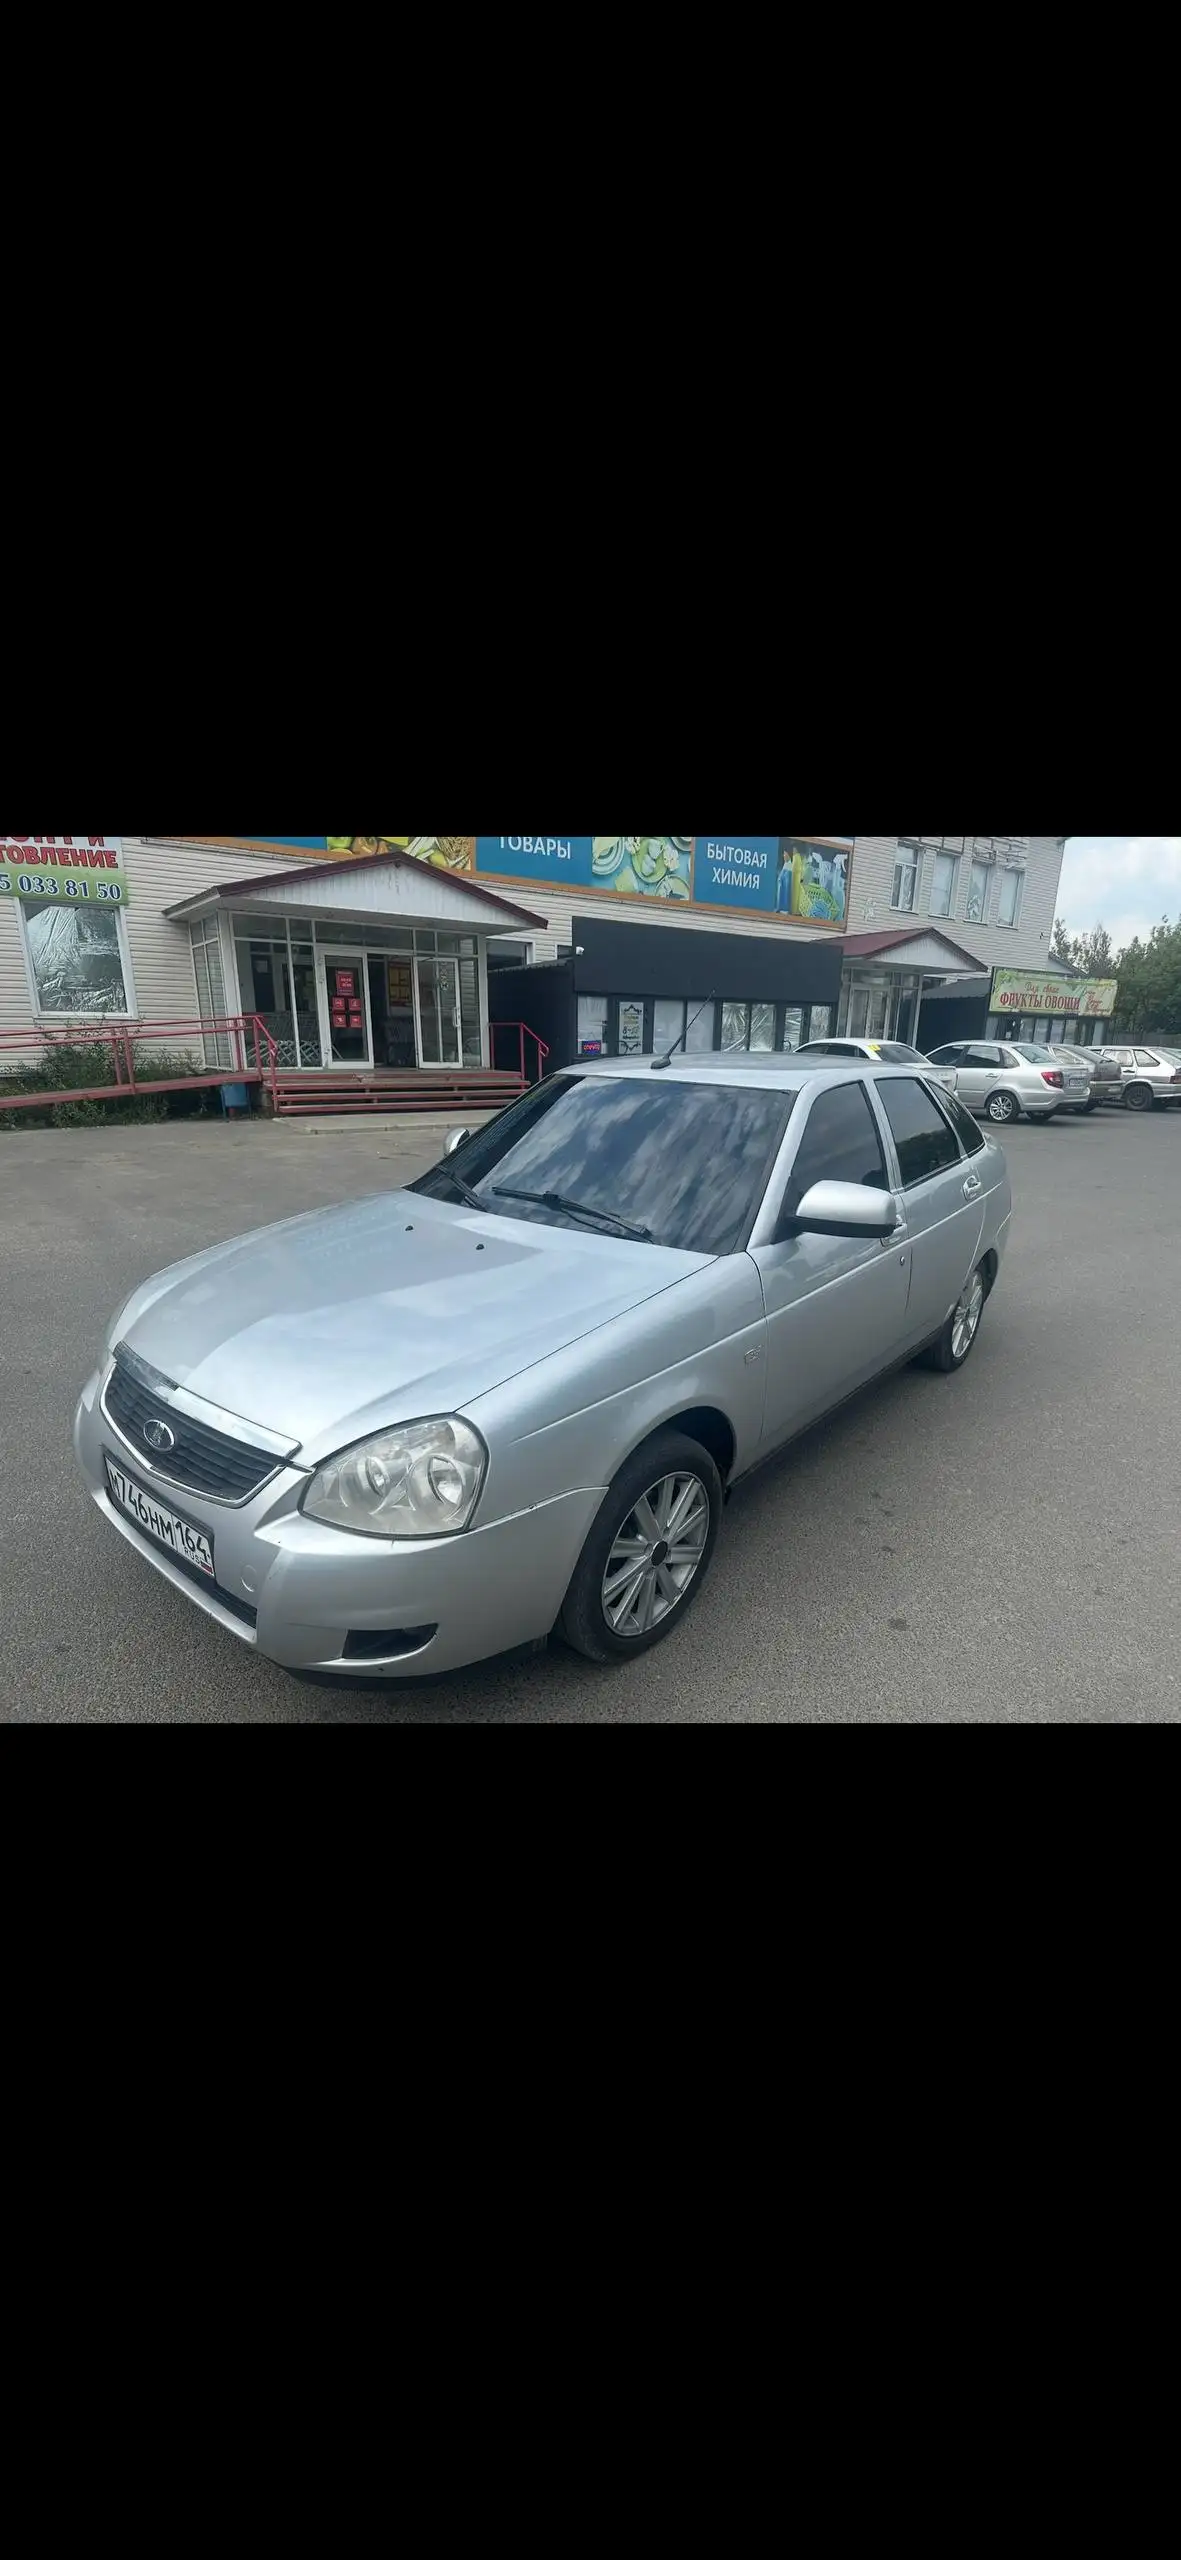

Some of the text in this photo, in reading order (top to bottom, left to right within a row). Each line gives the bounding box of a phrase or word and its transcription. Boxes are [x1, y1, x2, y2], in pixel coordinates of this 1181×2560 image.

[707, 842, 767, 868] БЫТОВАЯ
[19, 875, 58, 894] 033
[65, 880, 89, 896] 81
[97, 883, 121, 900] 50
[712, 867, 760, 889] ХИМИЯ
[1000, 992, 1041, 1008] ФРУКТЫ
[1044, 995, 1080, 1010] ОВОЩИ
[174, 1520, 210, 1563] 164
